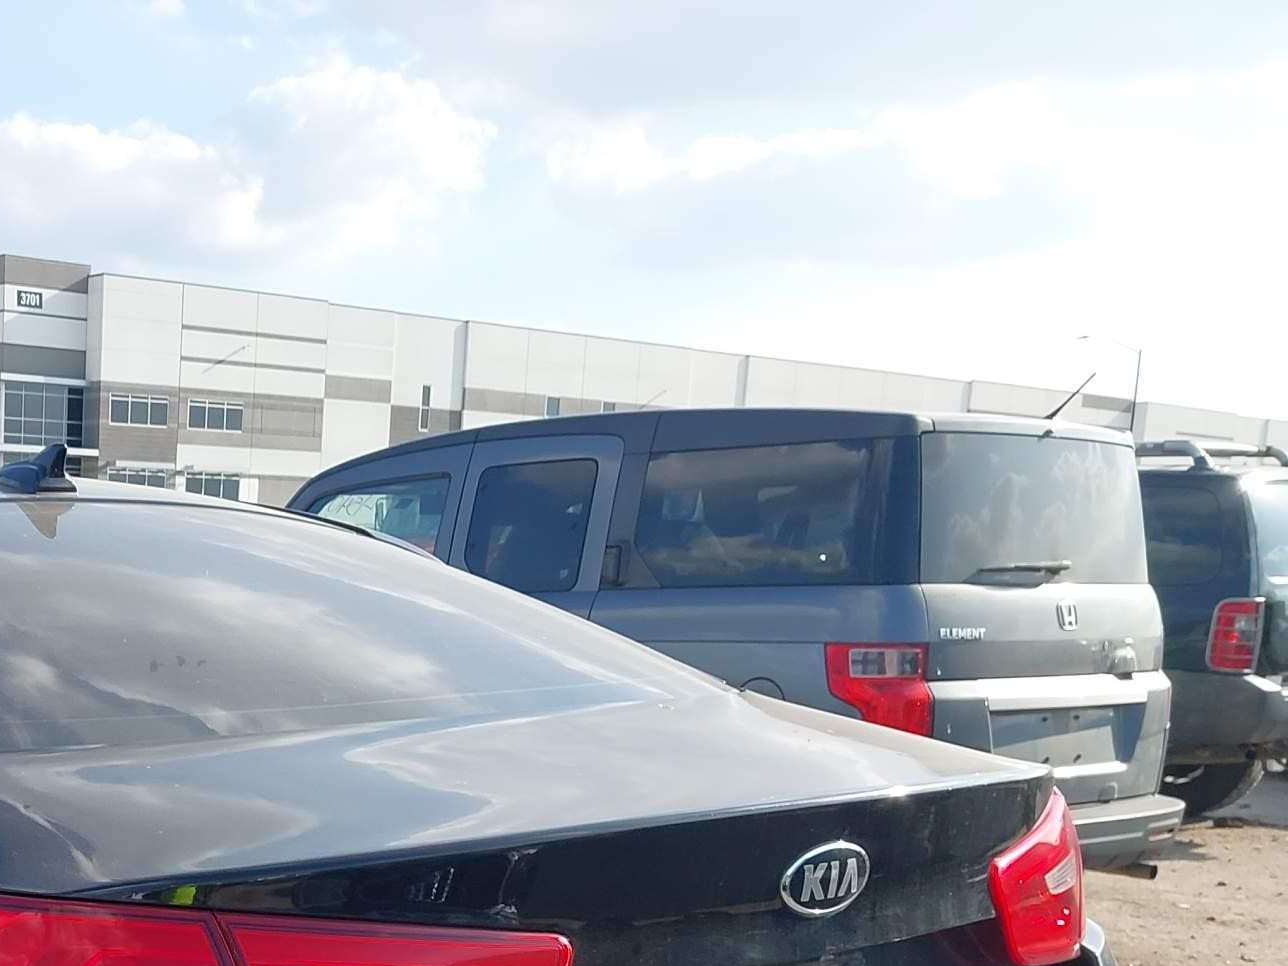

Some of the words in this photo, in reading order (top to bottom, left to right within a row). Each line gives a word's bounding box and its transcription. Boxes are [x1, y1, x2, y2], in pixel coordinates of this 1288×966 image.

[20, 293, 40, 306] 3701
[939, 627, 986, 640] ELEMENT
[800, 857, 858, 902] KIA
